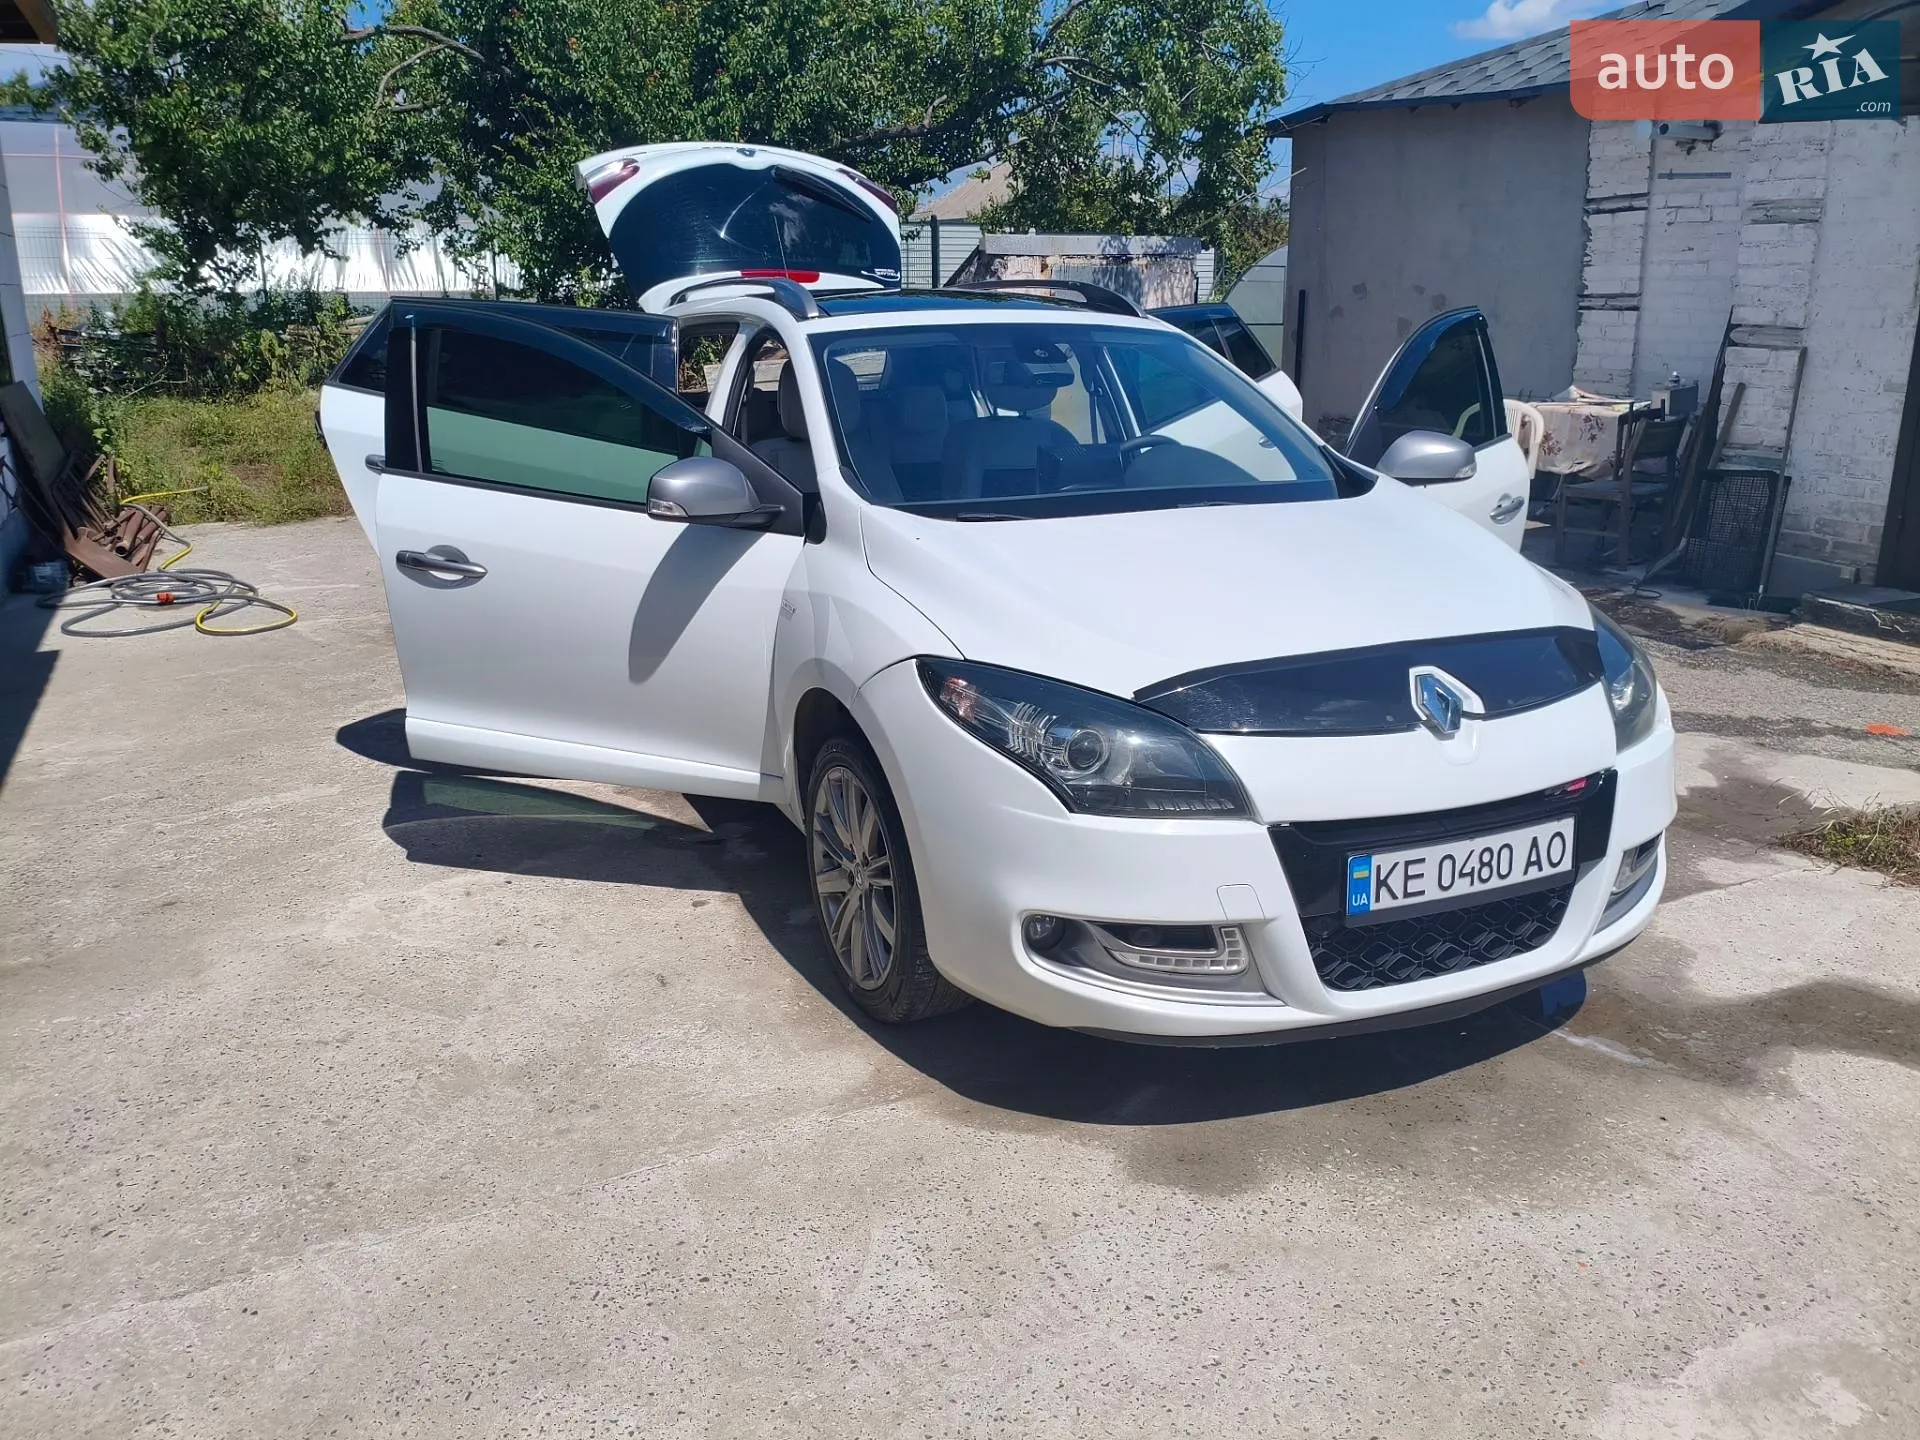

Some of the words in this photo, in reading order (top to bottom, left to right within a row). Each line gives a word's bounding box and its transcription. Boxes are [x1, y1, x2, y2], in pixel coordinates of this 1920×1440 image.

[1374, 857, 1426, 903] KE
[1437, 842, 1513, 892] 0480
[1522, 831, 1566, 876] AO
[1352, 893, 1368, 906] UA
